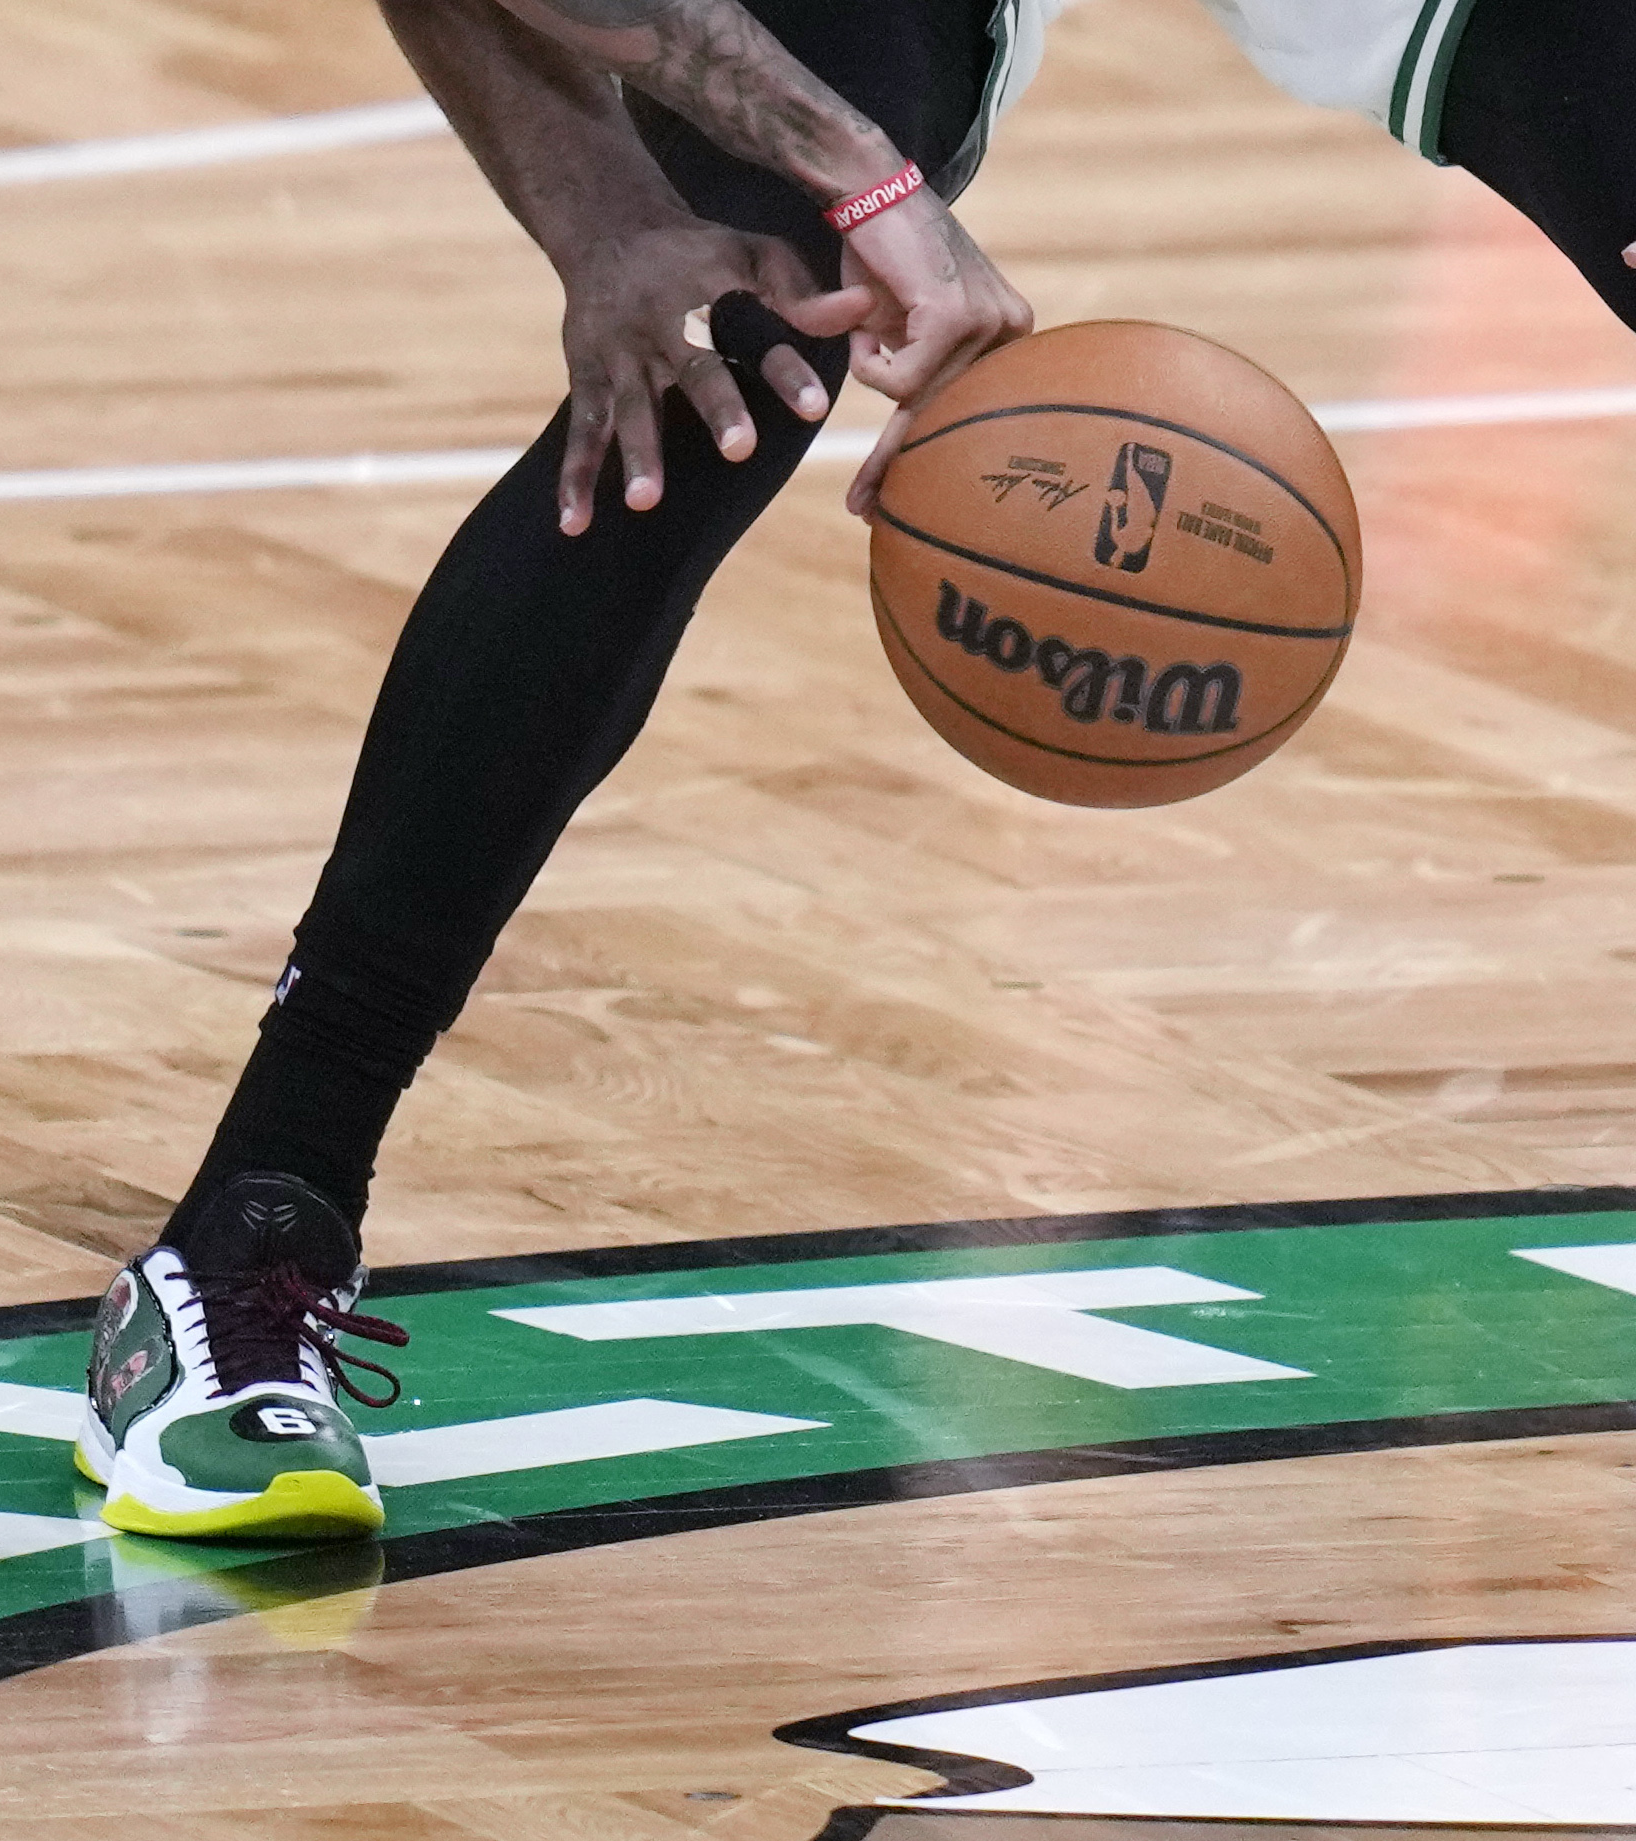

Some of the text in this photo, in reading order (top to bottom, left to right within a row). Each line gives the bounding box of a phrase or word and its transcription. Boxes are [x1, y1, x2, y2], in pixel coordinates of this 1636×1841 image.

[833, 177, 907, 228] MURRAY
[935, 578, 1244, 735] Wilson
[256, 1405, 318, 1436] 6
